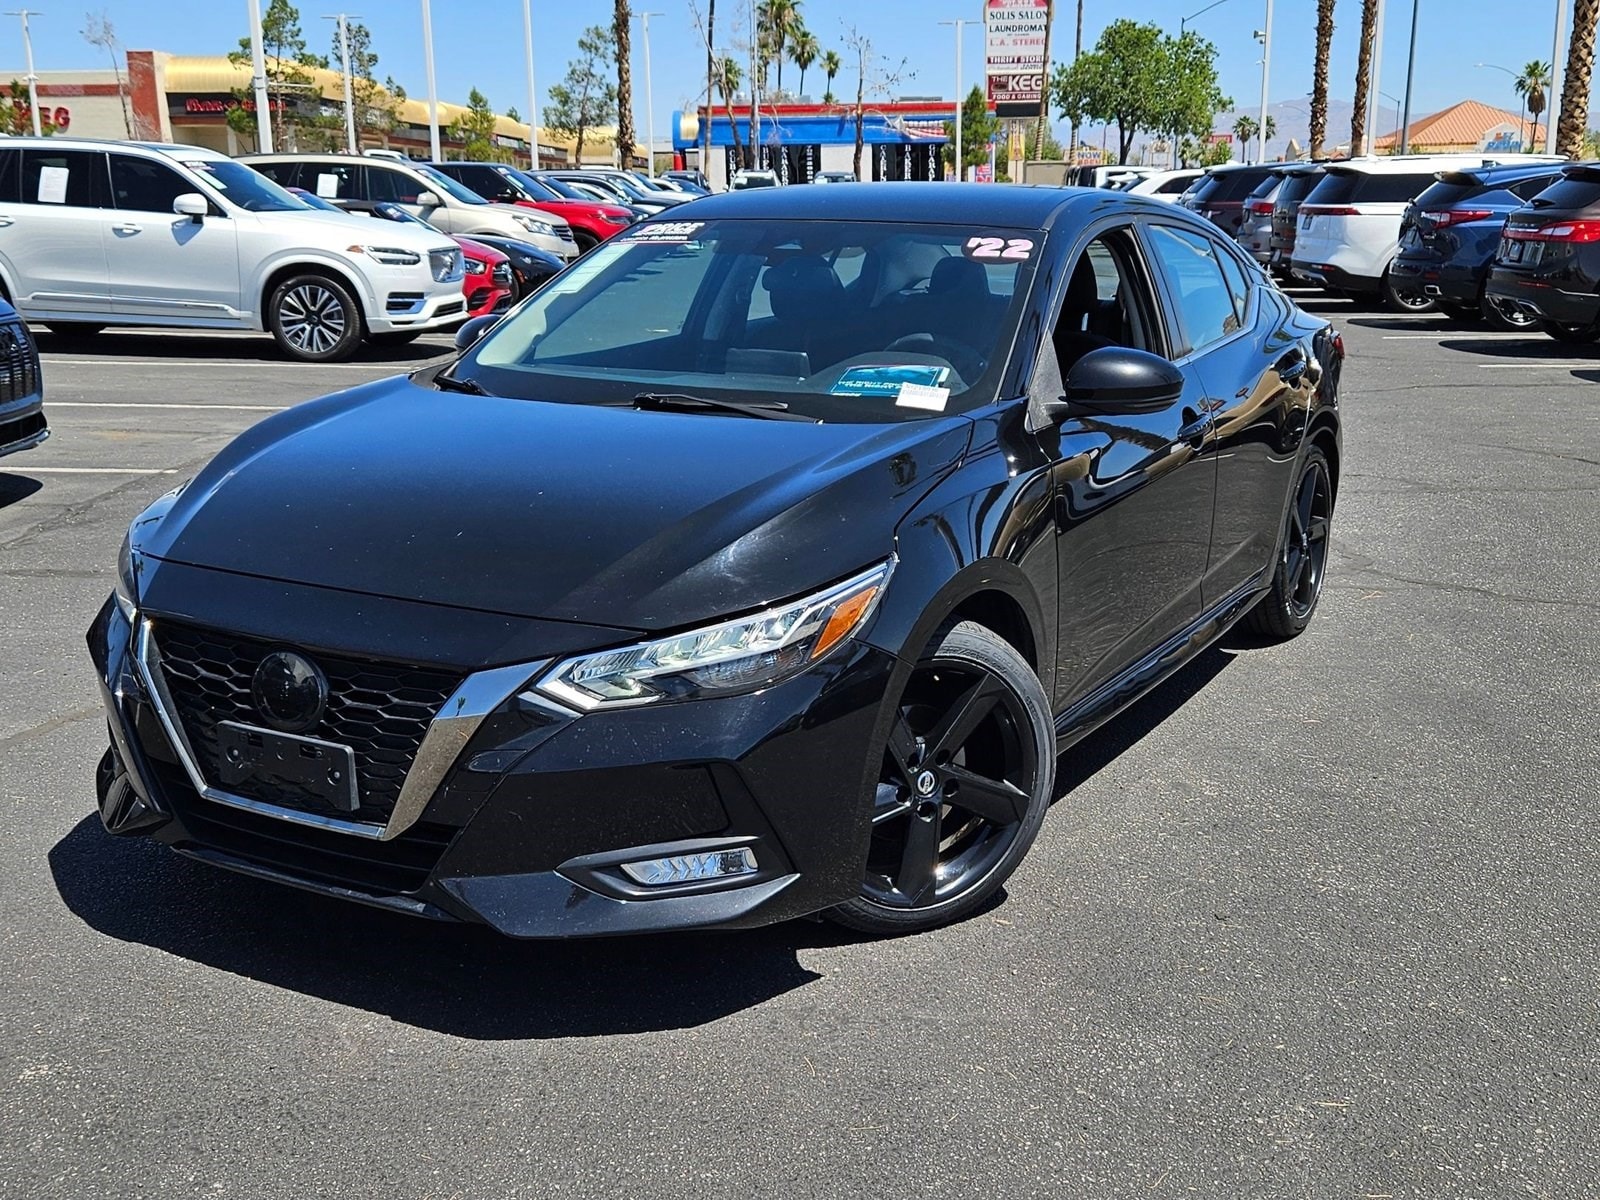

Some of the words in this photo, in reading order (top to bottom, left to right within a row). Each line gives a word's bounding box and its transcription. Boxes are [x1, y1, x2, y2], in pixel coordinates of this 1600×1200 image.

[990, 11, 1016, 20] SOLIS
[1008, 75, 1042, 91] KEG
[1077, 151, 1102, 159] NOW
[967, 237, 1034, 259] '22
